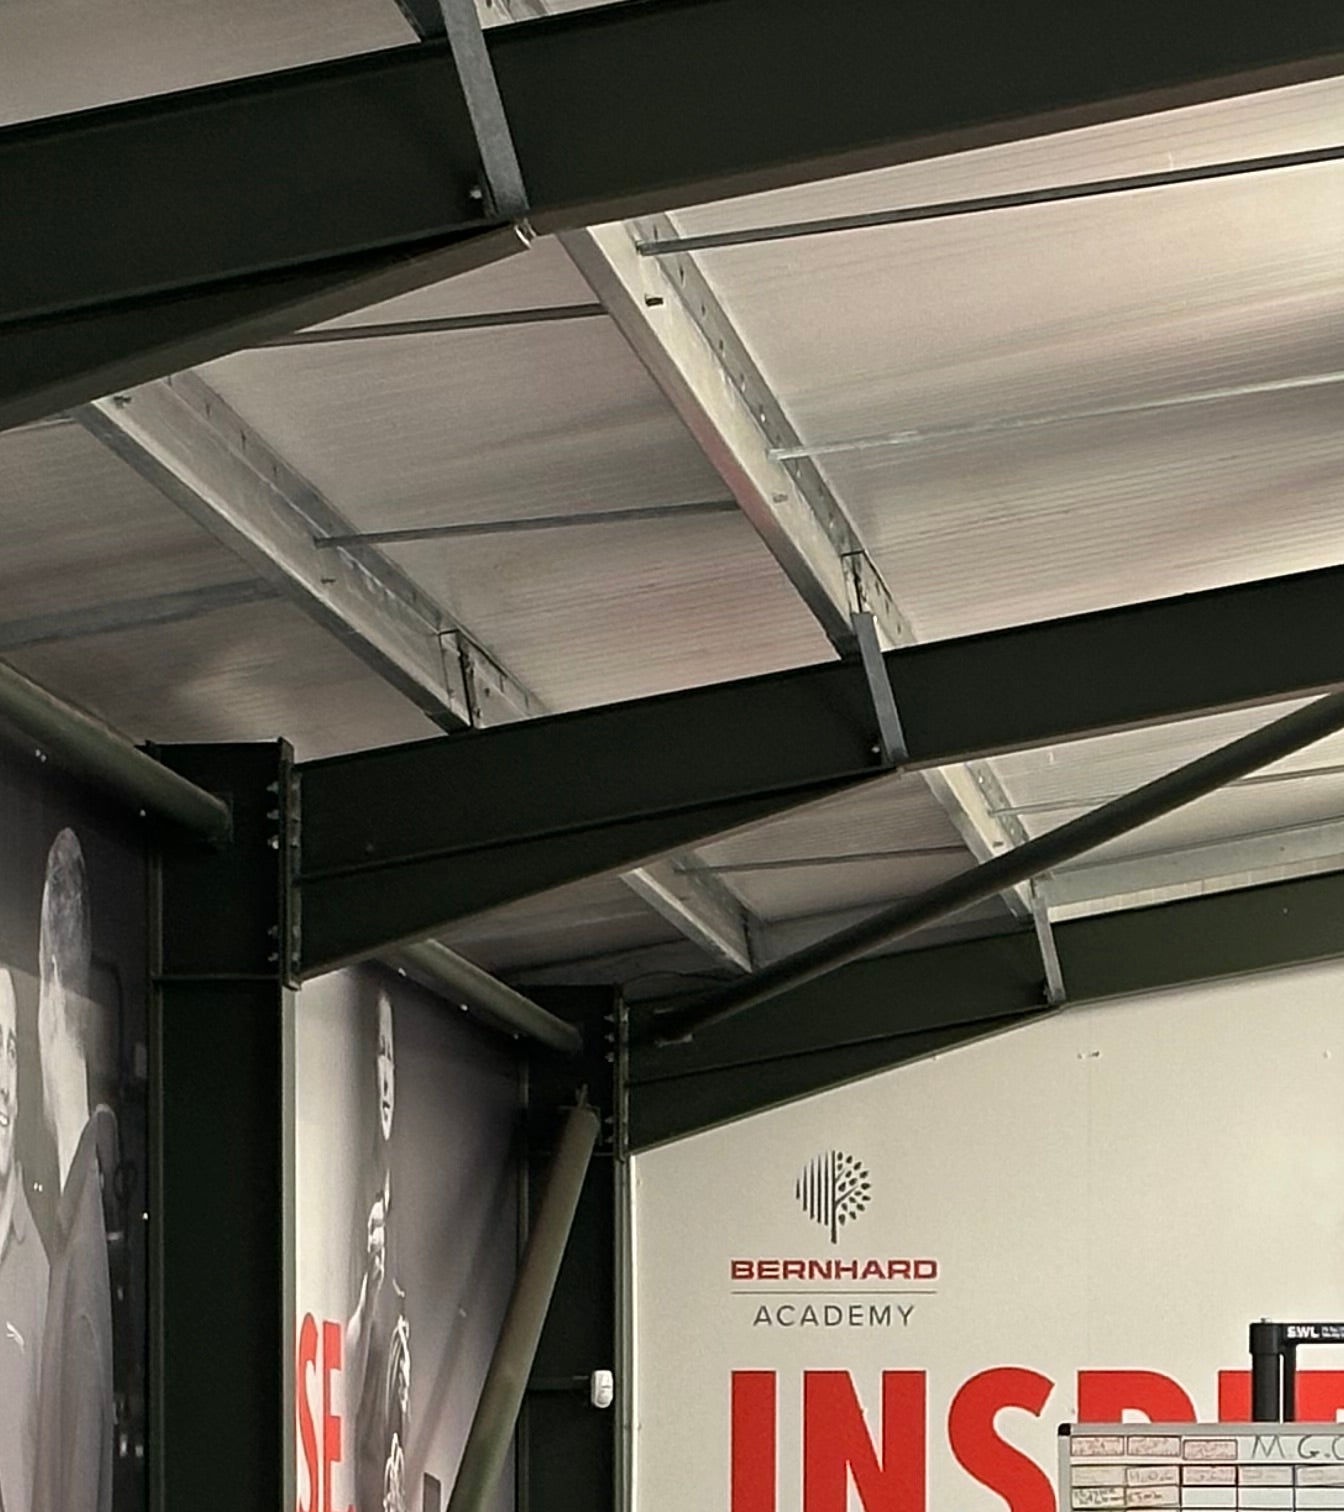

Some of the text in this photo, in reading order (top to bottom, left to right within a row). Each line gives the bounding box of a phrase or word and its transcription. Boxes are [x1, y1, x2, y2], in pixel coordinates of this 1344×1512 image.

[730, 1259, 938, 1280] BERNHARD
[753, 1305, 915, 1327] ACADEMY
[1287, 1326, 1319, 1338] SWL
